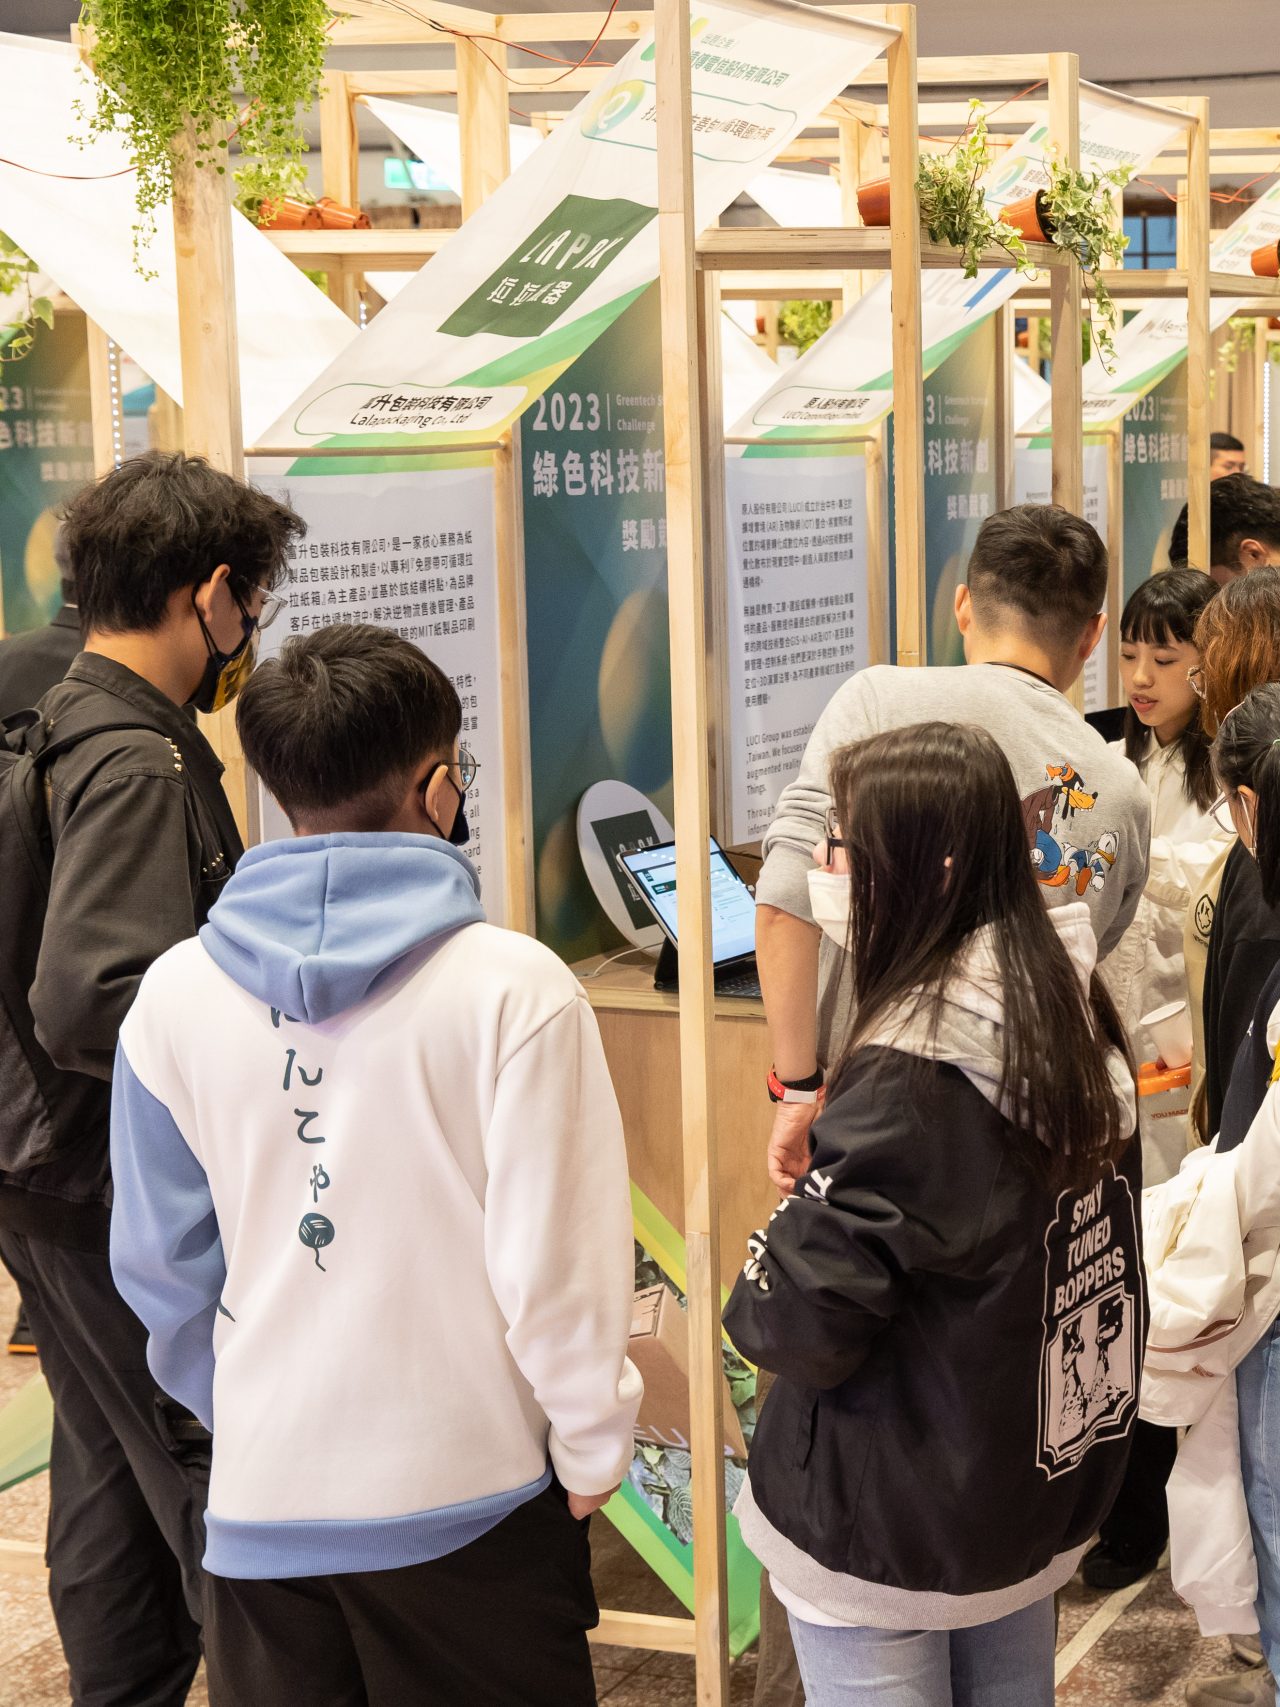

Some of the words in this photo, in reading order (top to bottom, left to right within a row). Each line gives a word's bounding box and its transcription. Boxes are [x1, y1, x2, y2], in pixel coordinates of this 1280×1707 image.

[533, 392, 601, 431] 2023
[617, 419, 656, 433] Challenge
[746, 733, 761, 747] LUCI
[762, 731, 780, 744] Group
[781, 727, 792, 739] was
[746, 762, 782, 780] augmented
[1070, 1179, 1104, 1233] STAY
[1067, 1215, 1112, 1273] TUNED
[1052, 1246, 1126, 1318] BOPPERS
